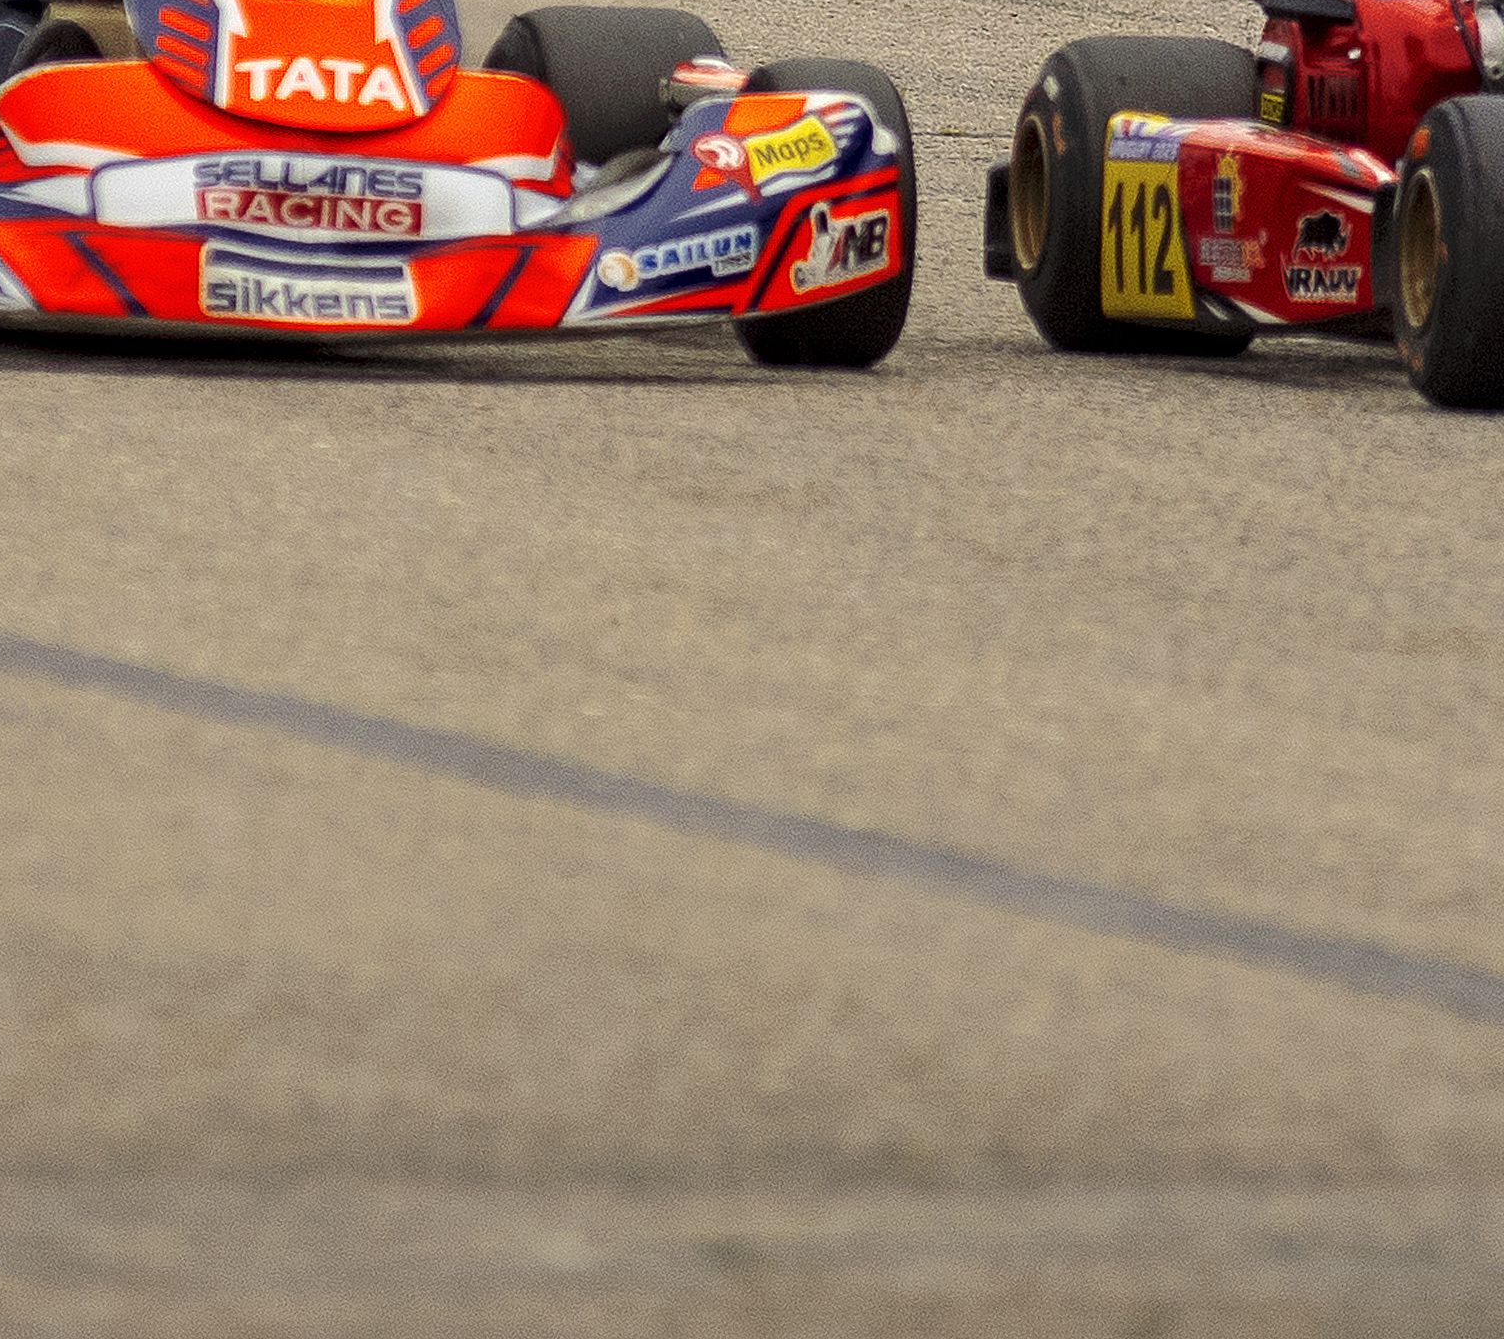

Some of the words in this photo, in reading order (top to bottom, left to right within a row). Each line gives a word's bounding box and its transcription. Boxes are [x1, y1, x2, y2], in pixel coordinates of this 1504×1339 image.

[234, 56, 407, 112] TATA
[753, 132, 826, 169] Maps
[203, 189, 413, 234] RACING
[638, 232, 755, 271] SAILUN
[1108, 181, 1175, 296] 112
[206, 278, 411, 320] Sikkens
